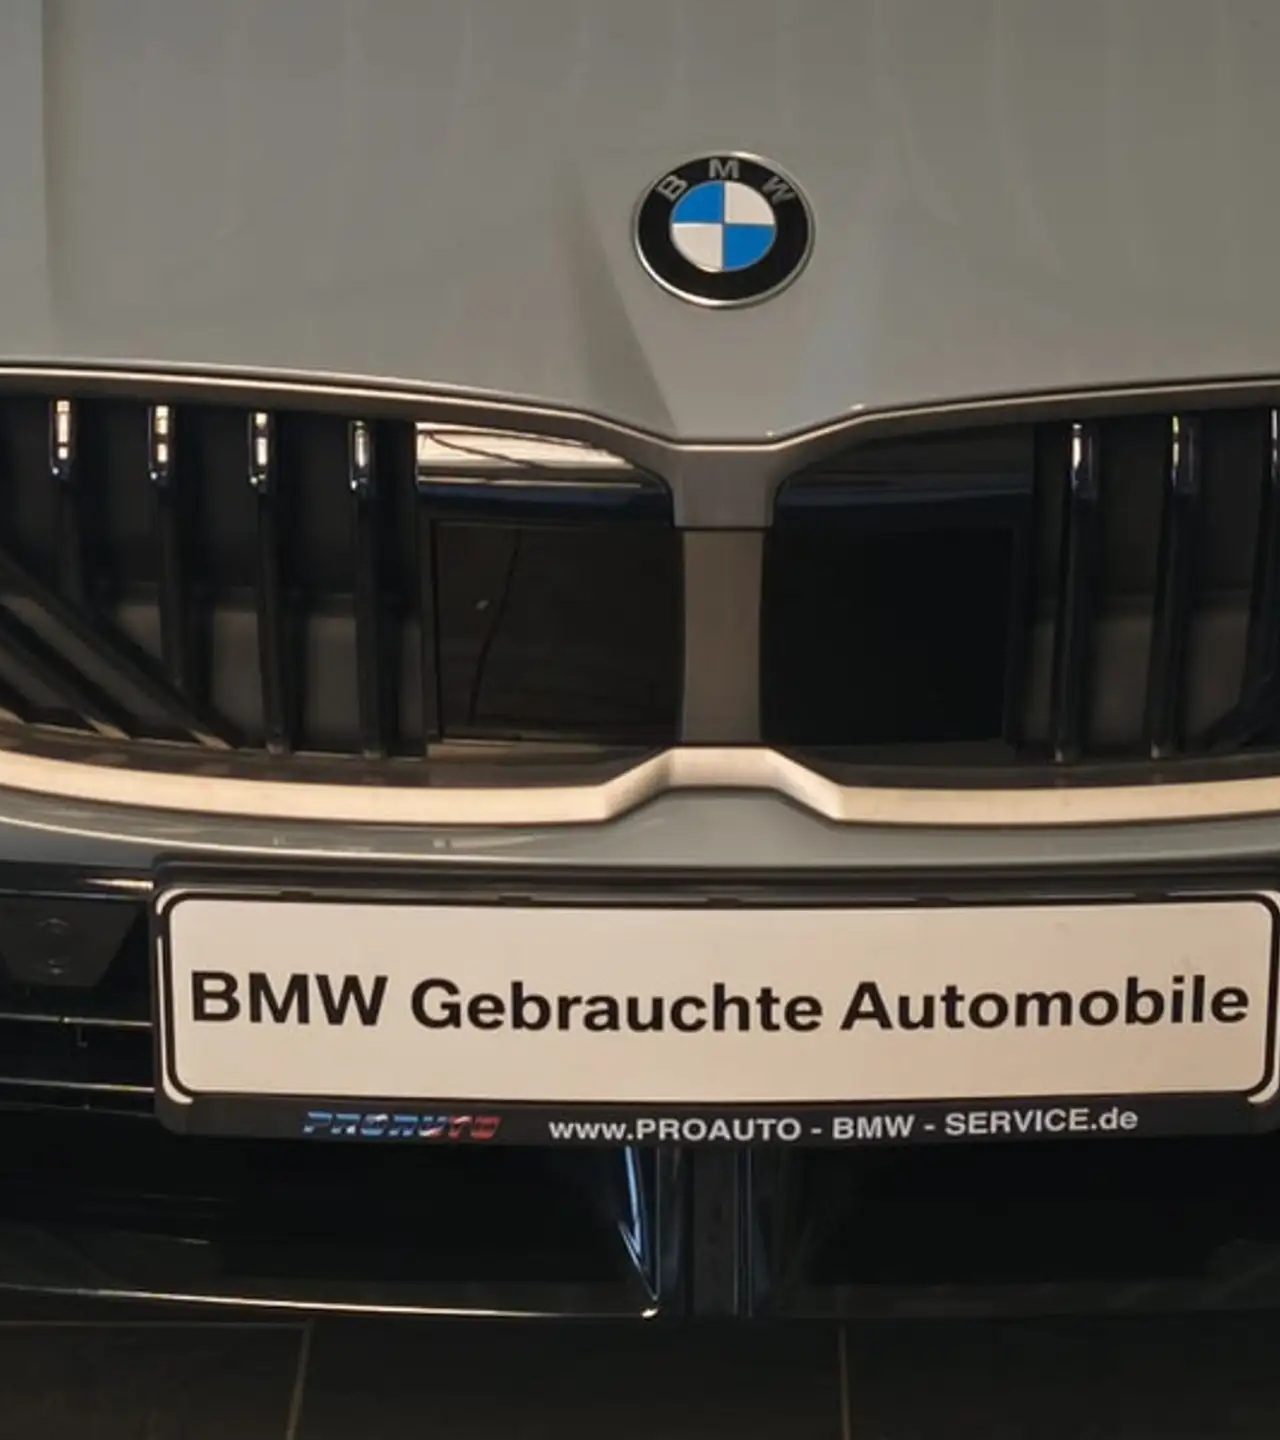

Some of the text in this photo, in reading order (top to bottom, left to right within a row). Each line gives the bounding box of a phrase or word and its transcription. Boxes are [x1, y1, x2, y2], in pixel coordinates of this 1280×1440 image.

[655, 158, 798, 206] BMW
[191, 969, 1250, 1033] BMW Gebrauchte Automobile
[548, 1116, 802, 1142] www.PROAUTO
[832, 1113, 915, 1139] BMW
[944, 1107, 1139, 1137] SERVICE.de
